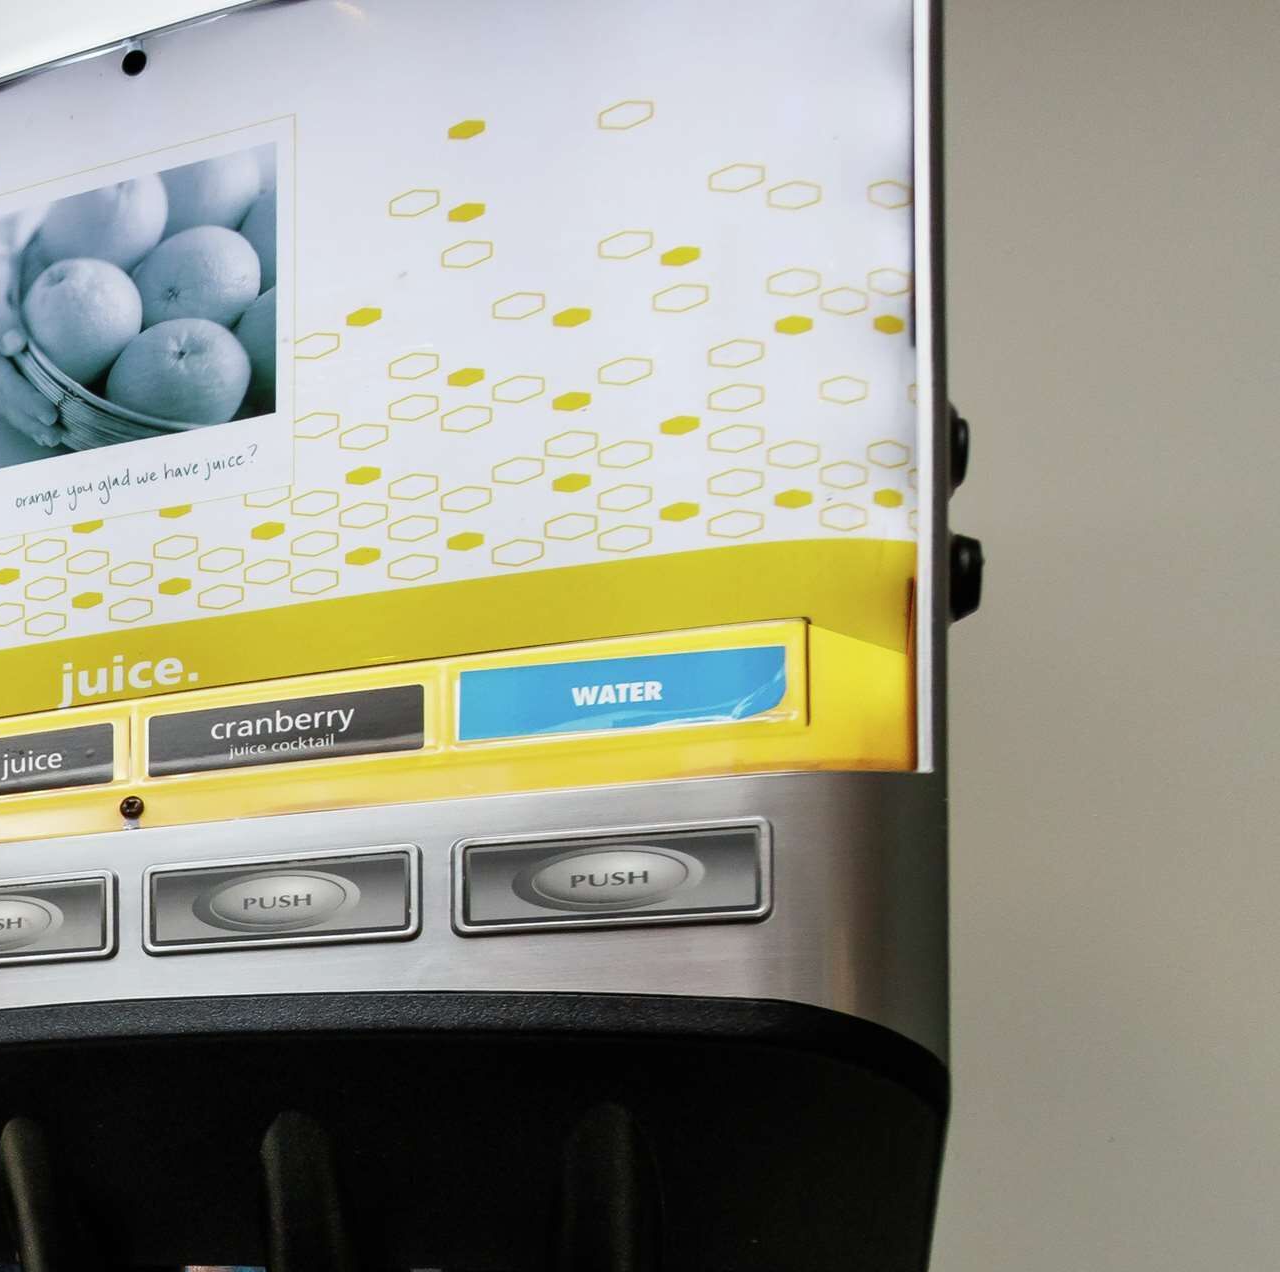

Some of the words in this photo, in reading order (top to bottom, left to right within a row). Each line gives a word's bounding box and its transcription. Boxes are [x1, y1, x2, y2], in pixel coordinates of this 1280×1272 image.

[15, 488, 61, 516] orange
[66, 483, 92, 511] you
[98, 468, 131, 505] glad
[136, 471, 158, 485] we
[164, 462, 199, 480] have
[58, 655, 199, 708] juice.
[572, 681, 663, 707] WATER
[211, 708, 355, 740] cranberry
[228, 743, 267, 760] juice
[271, 733, 334, 752] cocktail
[1, 750, 63, 781] juice
[570, 870, 649, 888] PUSH
[243, 893, 312, 910] PUSH
